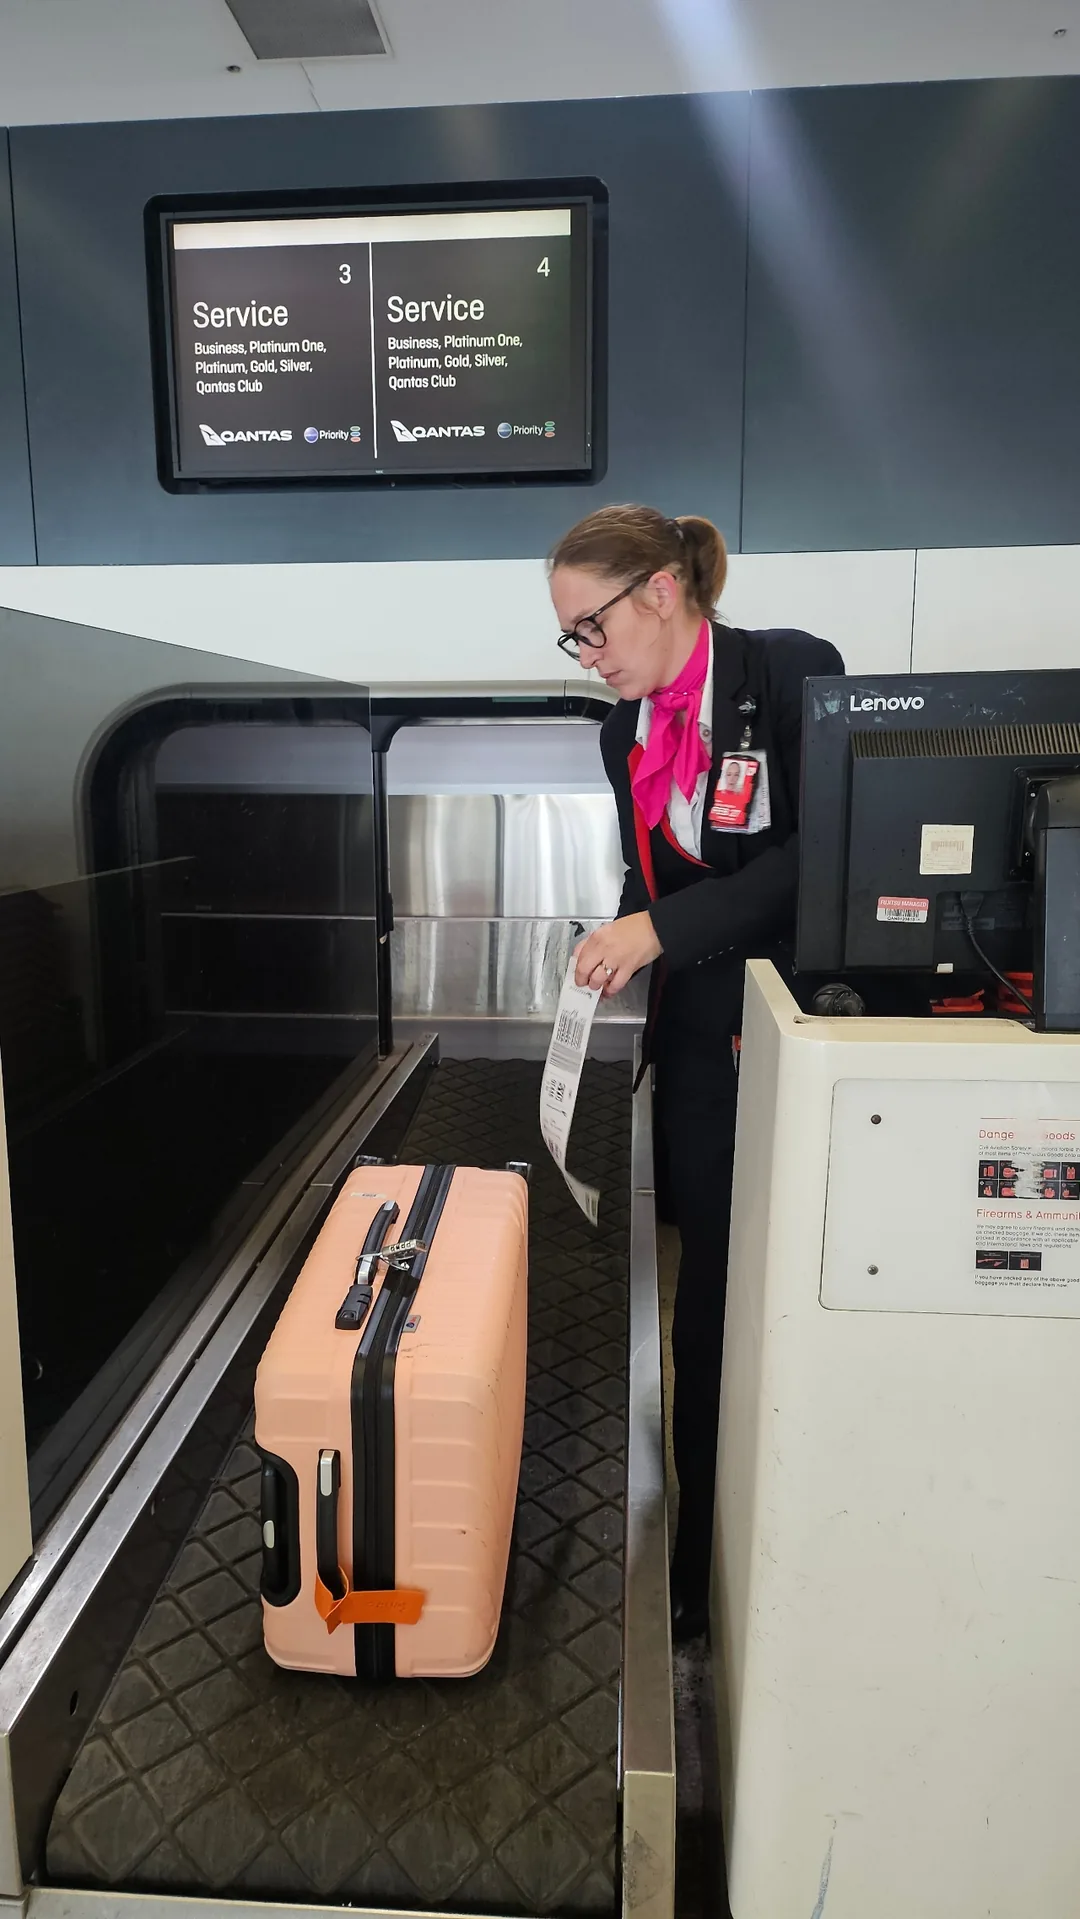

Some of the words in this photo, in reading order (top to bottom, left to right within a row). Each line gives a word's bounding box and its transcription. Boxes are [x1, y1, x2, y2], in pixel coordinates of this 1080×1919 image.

[338, 263, 352, 284] 3
[536, 257, 550, 277] 4
[193, 300, 288, 329] Service
[387, 294, 484, 323] Service
[194, 342, 247, 356] Business,
[249, 340, 300, 354] Platinum
[302, 339, 327, 354] One,
[388, 336, 442, 351] Business,
[444, 334, 495, 349] Platinum
[497, 334, 523, 348] One,
[195, 360, 248, 376] Platinum,
[250, 360, 278, 374] Gold,
[280, 359, 313, 374] Silver,
[388, 355, 442, 370] Platinum,
[444, 354, 472, 368] Gold,
[474, 354, 508, 368] Silver,
[196, 381, 236, 395] Qantas
[237, 380, 263, 392] Club
[388, 376, 429, 390] Qantas
[431, 374, 456, 388] Club
[220, 429, 293, 442] QANTAS
[319, 429, 350, 442] Priority
[411, 426, 486, 439] QANTAS
[513, 424, 544, 438] Priority
[850, 695, 925, 712] Lenovo
[976, 1208, 1022, 1219] Firearms
[1026, 1210, 1033, 1220] &
